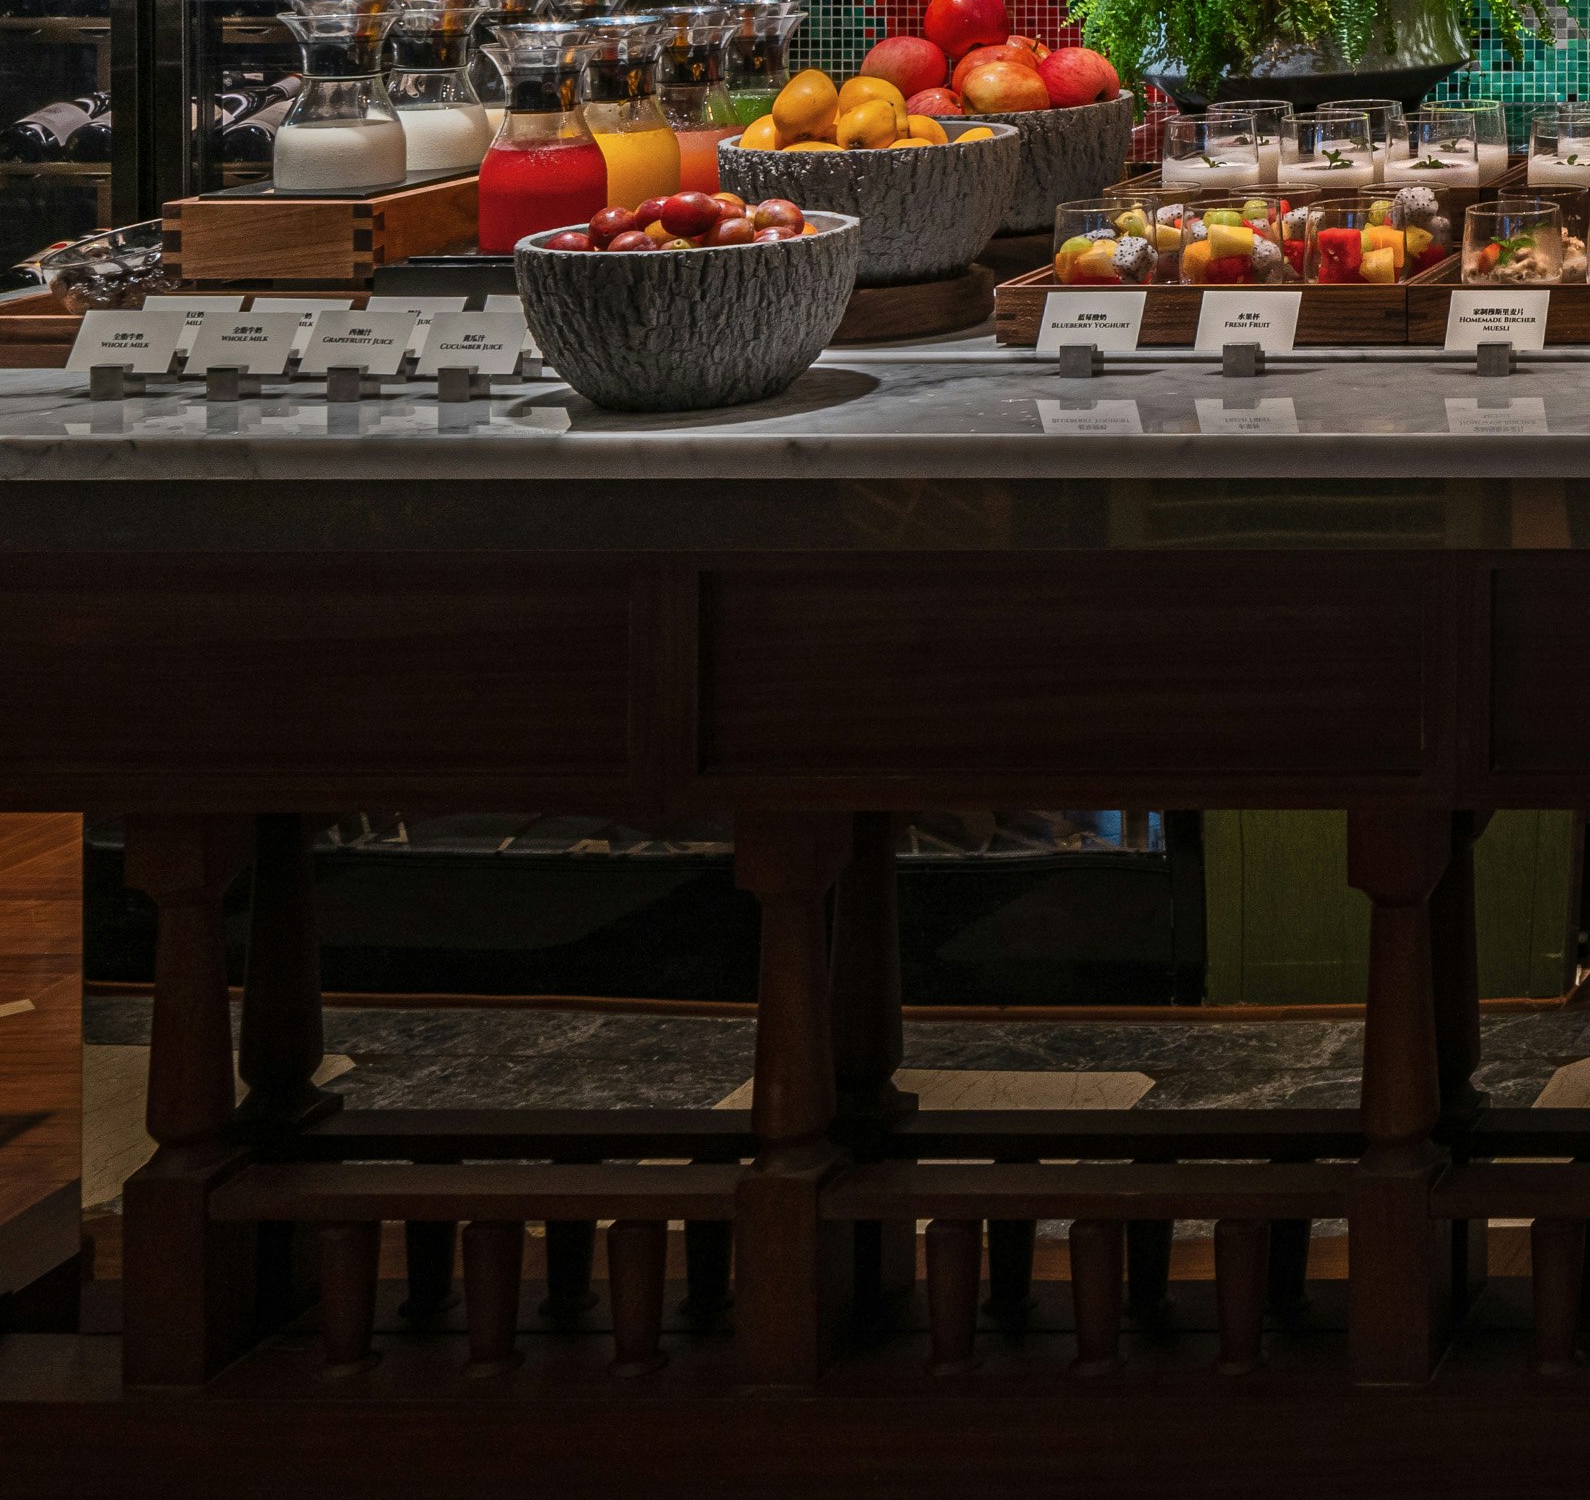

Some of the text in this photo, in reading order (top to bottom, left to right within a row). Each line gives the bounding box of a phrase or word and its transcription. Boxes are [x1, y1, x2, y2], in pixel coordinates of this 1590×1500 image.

[1077, 313, 1107, 321] 蓝莓酸奶
[1237, 312, 1261, 321] 水果杯
[233, 326, 263, 334] 全脂牛奶
[113, 333, 144, 341] 全脂牛奶
[463, 334, 486, 342] 黄瓜汁
[482, 343, 504, 351] JUICE
